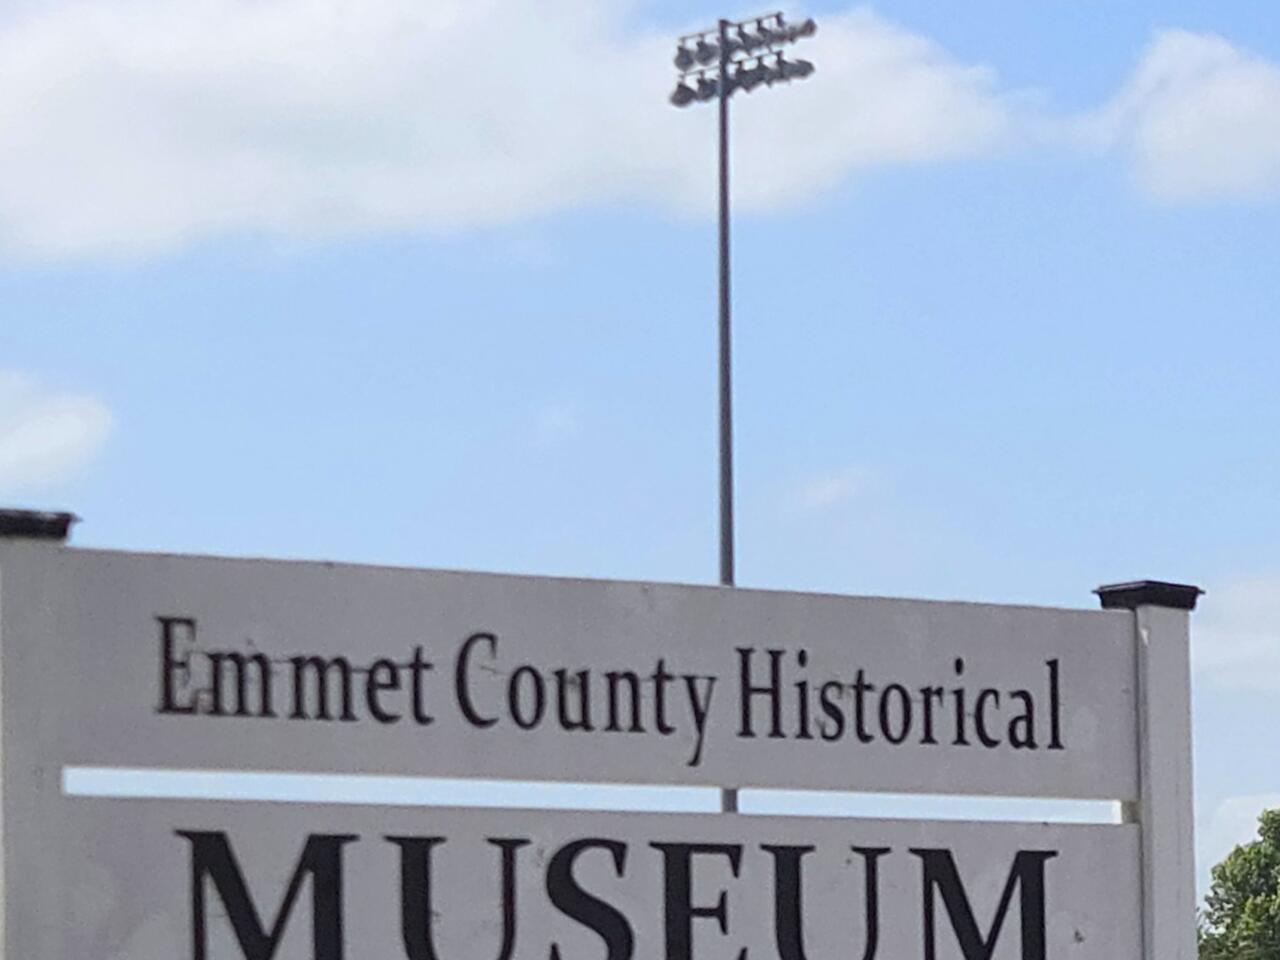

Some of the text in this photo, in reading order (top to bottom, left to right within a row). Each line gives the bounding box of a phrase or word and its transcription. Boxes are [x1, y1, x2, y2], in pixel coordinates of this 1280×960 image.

[154, 615, 1066, 768] Emmet County Historical
